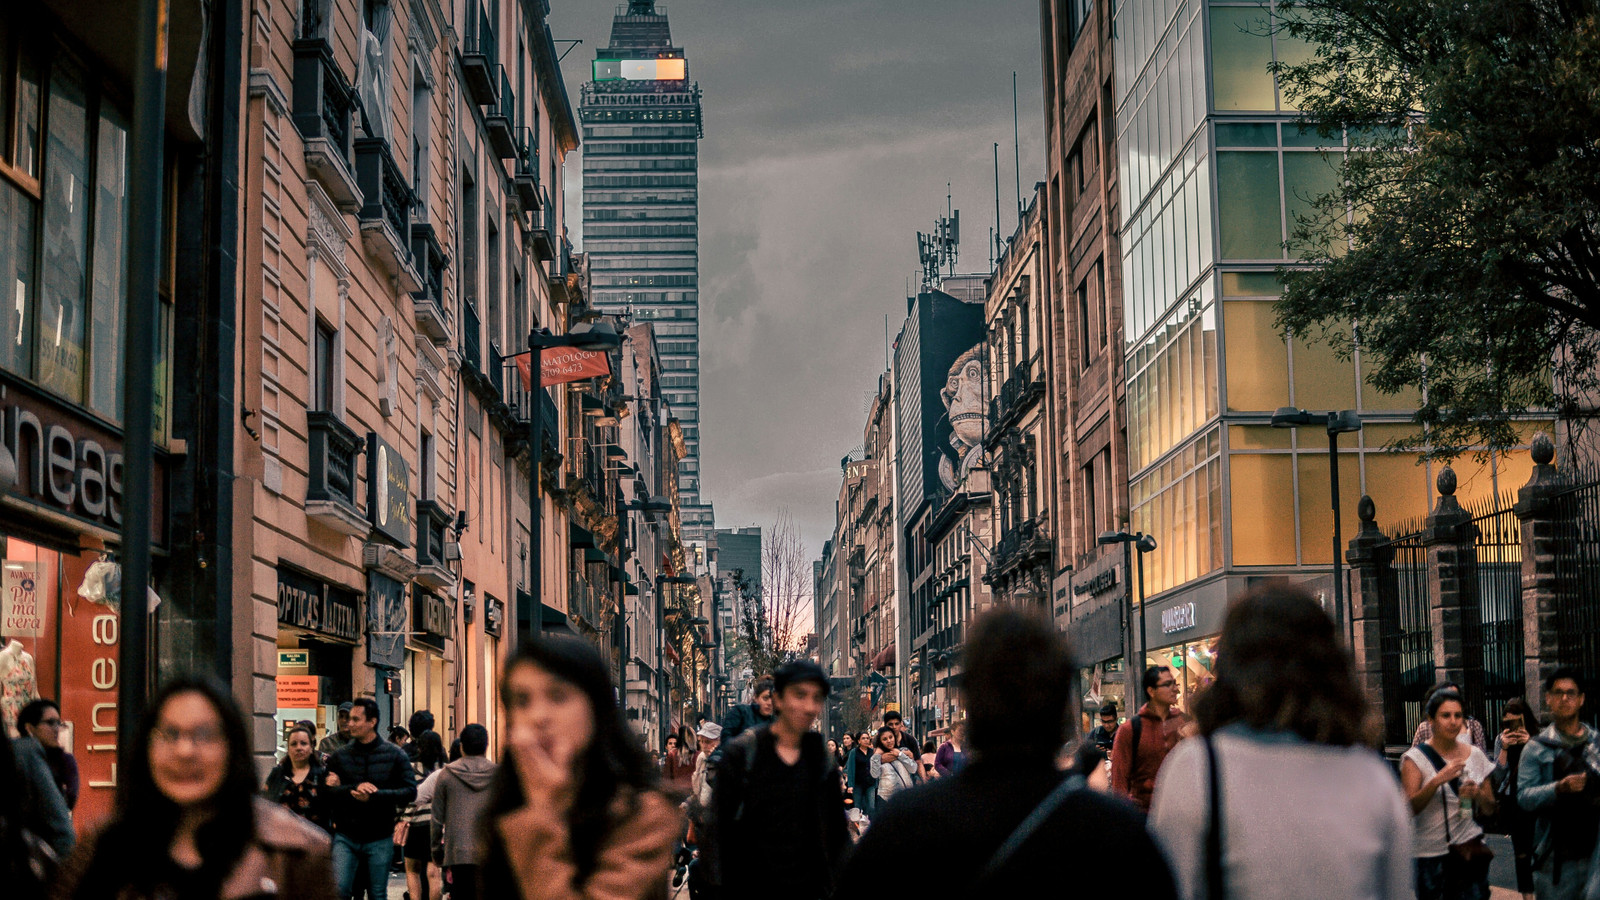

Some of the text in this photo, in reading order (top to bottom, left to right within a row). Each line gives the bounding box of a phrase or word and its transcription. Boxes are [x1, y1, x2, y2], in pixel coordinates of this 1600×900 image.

[587, 94, 692, 105] LATINOAMERICANA
[562, 362, 583, 374] 6473
[277, 582, 320, 630] OPTICAS
[6, 616, 41, 629] vera
